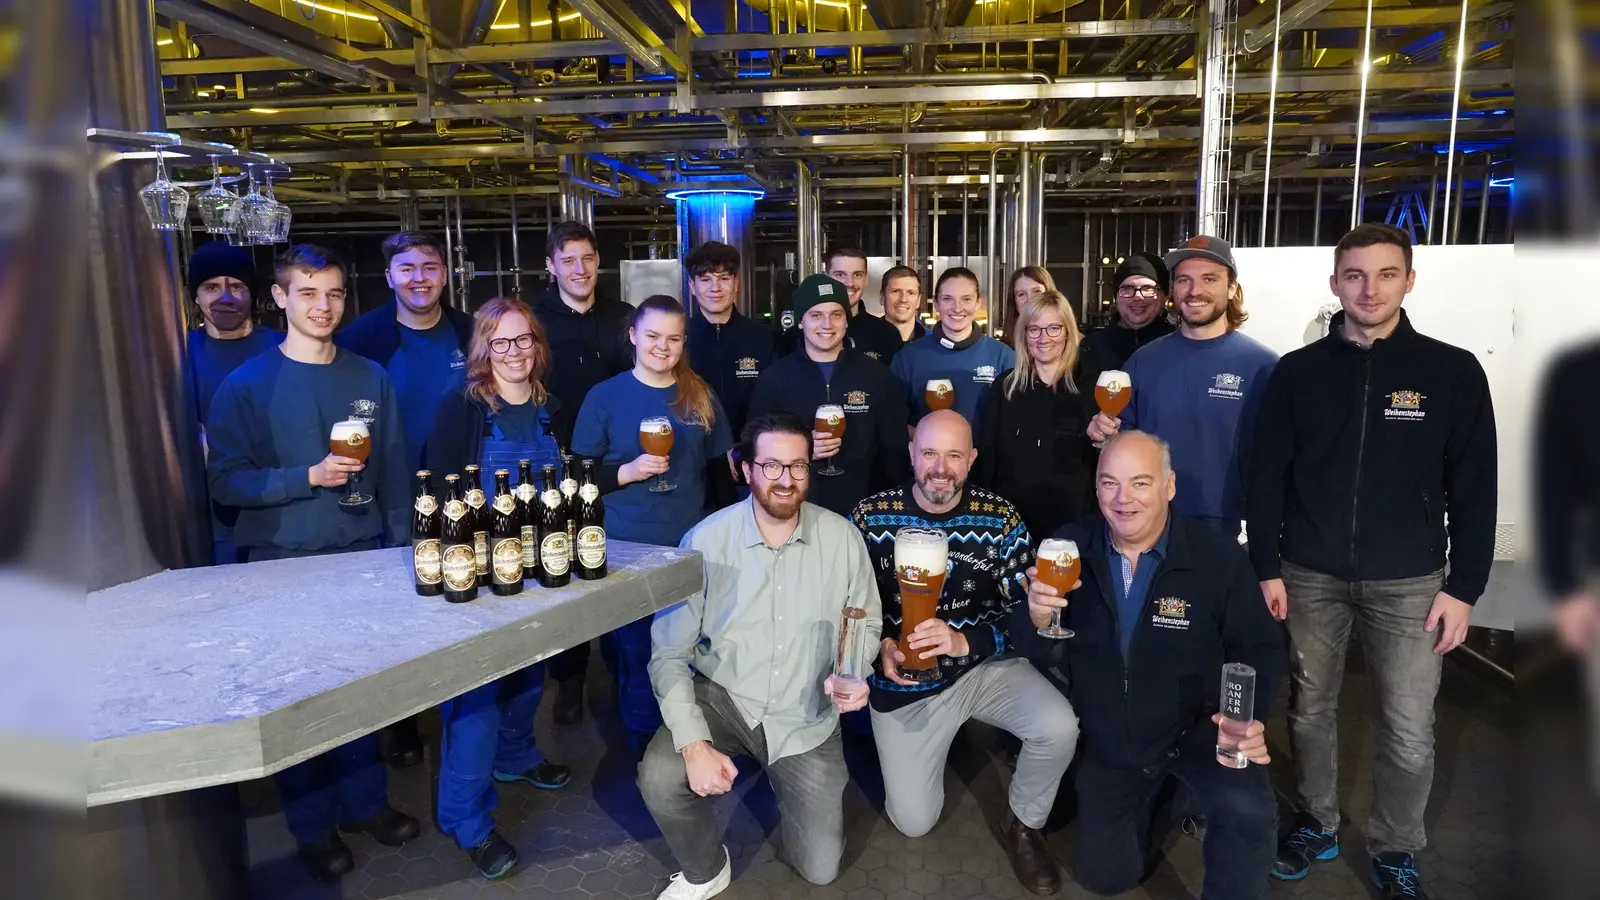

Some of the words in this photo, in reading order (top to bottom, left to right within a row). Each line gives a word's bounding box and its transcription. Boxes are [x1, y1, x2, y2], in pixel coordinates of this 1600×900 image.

[1384, 408, 1426, 417] Weihenstephan
[948, 550, 994, 572] wonderful
[951, 598, 971, 610] beer
[1152, 614, 1190, 626] Weihenstephan
